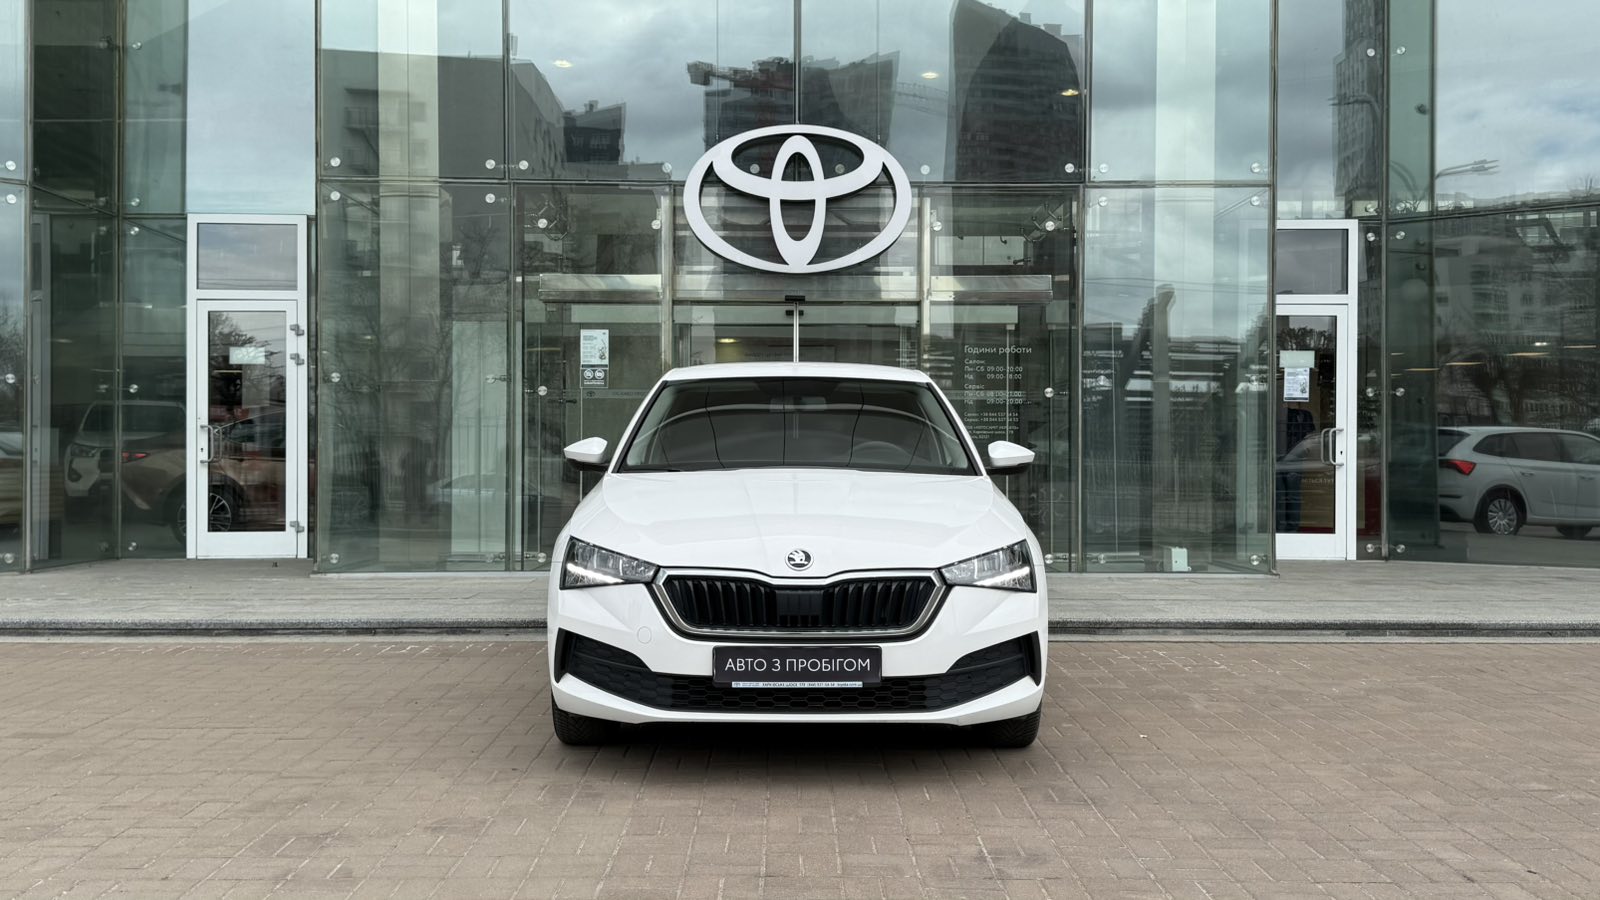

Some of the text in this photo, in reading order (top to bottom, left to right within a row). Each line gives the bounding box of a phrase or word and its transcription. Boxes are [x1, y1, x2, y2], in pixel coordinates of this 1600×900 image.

[964, 344, 1032, 355] Години роботи
[724, 658, 871, 672] АВТО З ПРОБІГОМ
